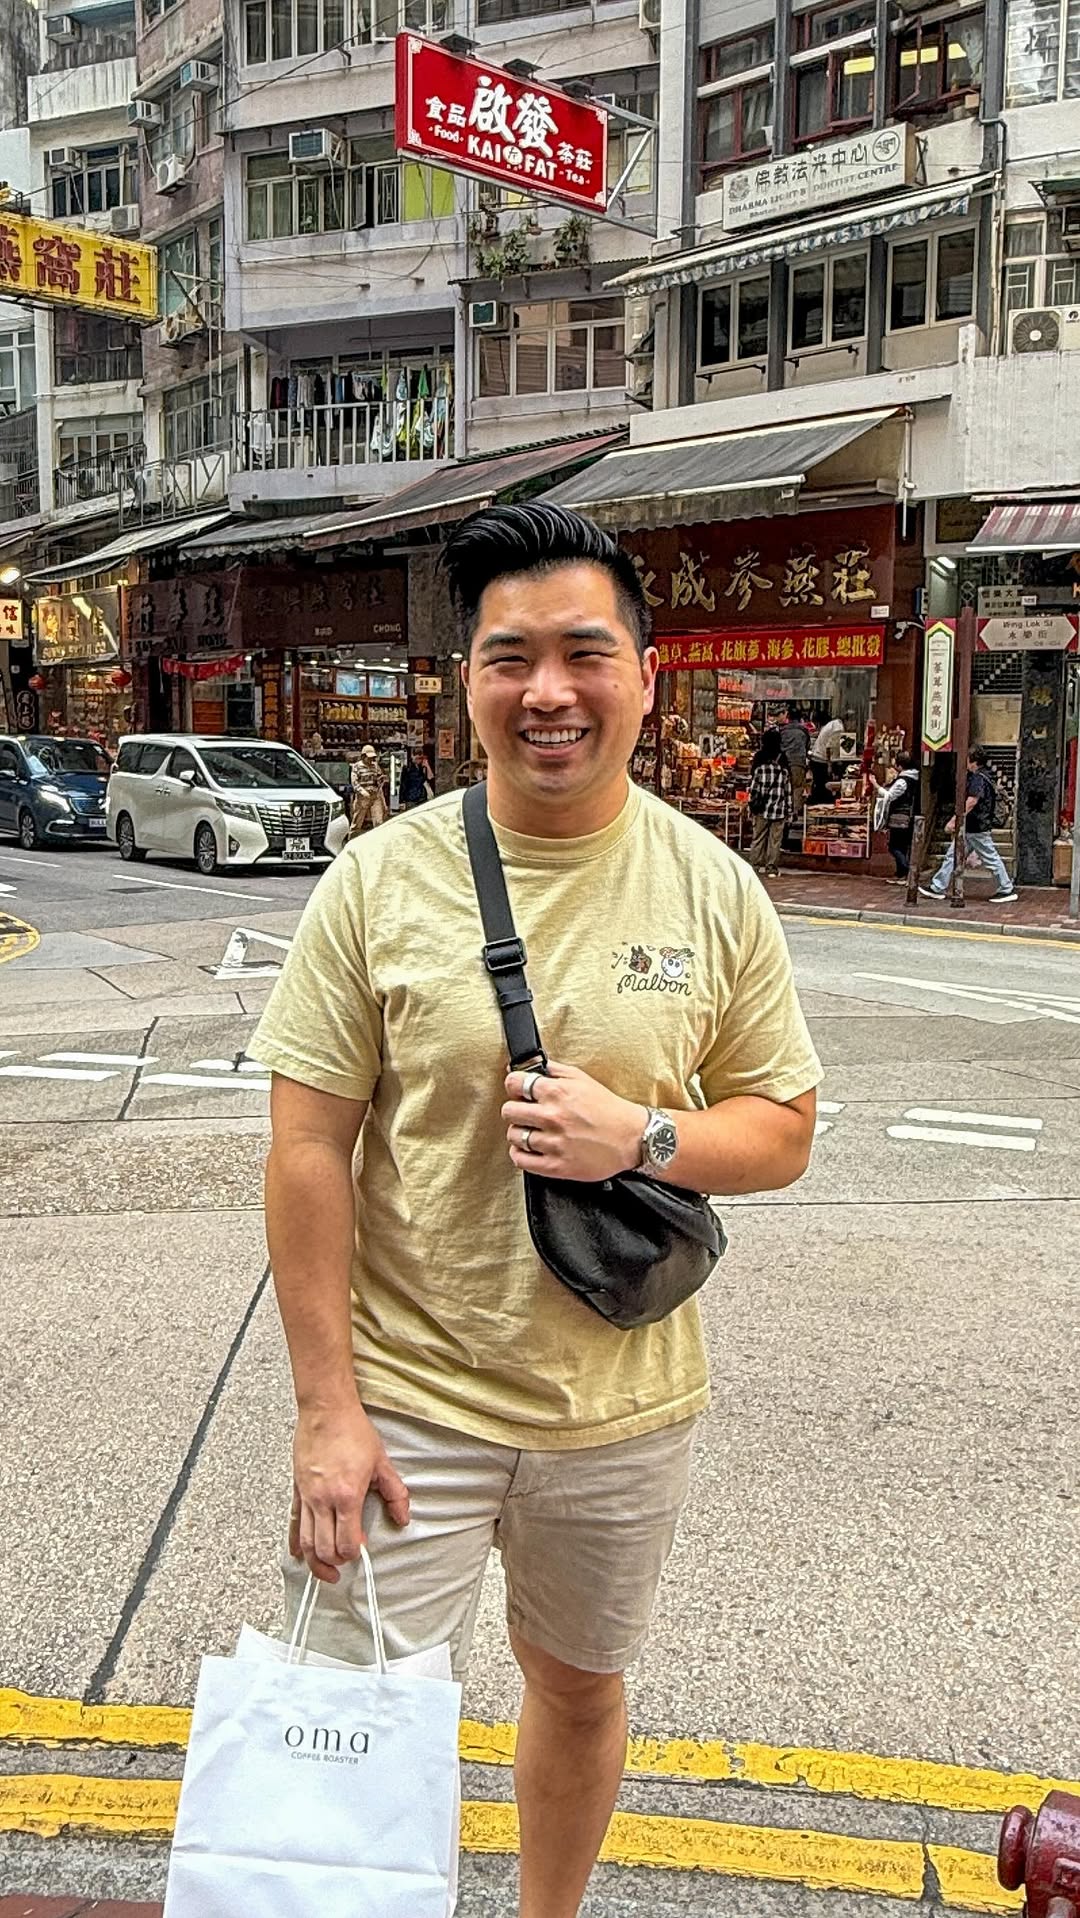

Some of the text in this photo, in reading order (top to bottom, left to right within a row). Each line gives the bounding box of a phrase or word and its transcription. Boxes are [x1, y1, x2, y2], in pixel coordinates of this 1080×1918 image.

[425, 95, 467, 128] 食品
[467, 134, 502, 163] KAI
[524, 153, 558, 181] FAT
[755, 142, 868, 193] 佛教法光中心
[728, 197, 768, 215] DHARMA
[857, 163, 899, 181] CENTRE
[3, 605, 18, 621] 信
[1025, 619, 1041, 628] Lok
[616, 973, 692, 996] Malbon
[285, 1725, 369, 1754] oma
[290, 1750, 359, 1765] COFFEE ROASTER
